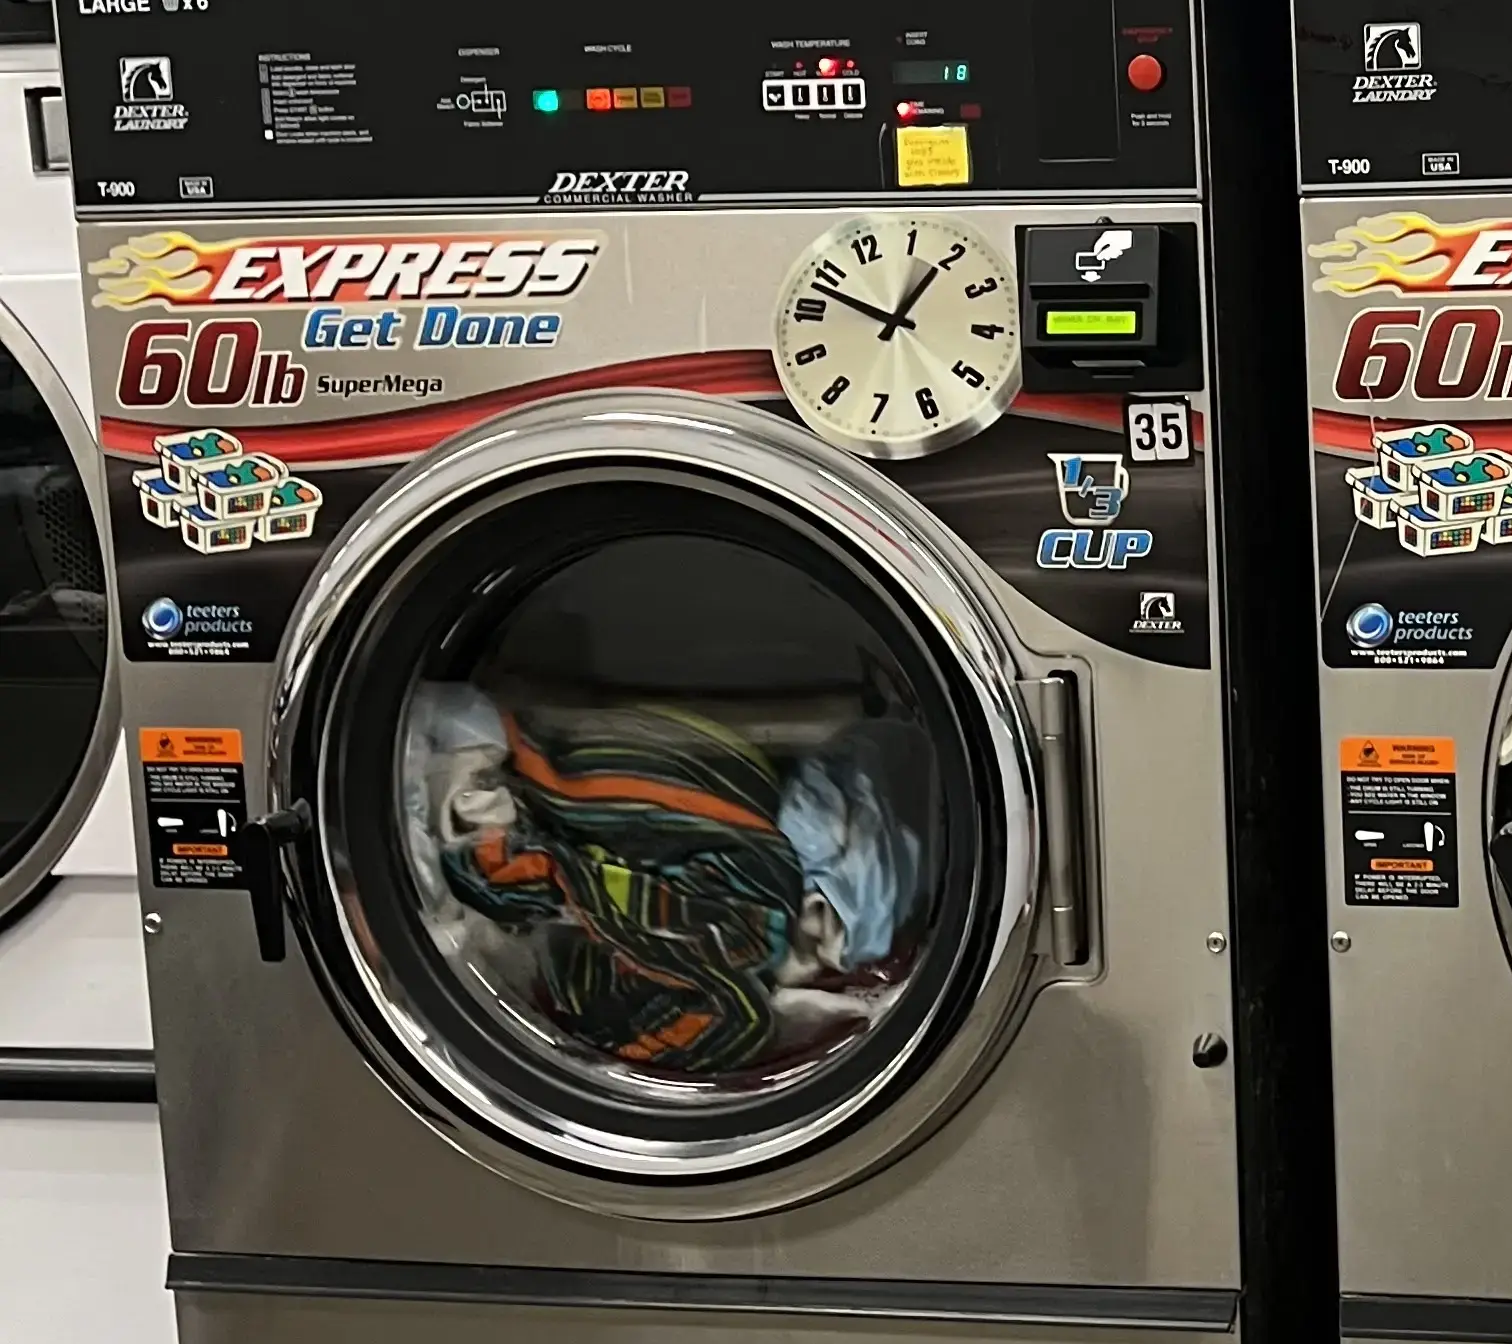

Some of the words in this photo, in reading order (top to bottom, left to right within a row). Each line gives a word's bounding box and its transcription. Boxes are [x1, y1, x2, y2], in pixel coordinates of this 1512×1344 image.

[771, 40, 794, 49] WASH
[795, 39, 851, 48] TEMPERATURE
[1352, 74, 1437, 89] DEXTER
[1352, 88, 1437, 103] LAUNDRY
[113, 104, 189, 119] DEXTER
[114, 118, 188, 131] LAUNDRY
[1327, 158, 1371, 175] T-900
[1430, 162, 1452, 172] USA
[97, 181, 136, 197] T-900
[548, 170, 689, 193] DEXTER
[543, 192, 631, 204] COMMERCIAL
[637, 191, 693, 203] WASHER
[851, 234, 883, 265] 12
[907, 229, 917, 256] 1
[938, 243, 966, 271] 2
[209, 239, 600, 303] EXPRESS
[815, 259, 847, 288] 11
[964, 277, 998, 299] 3
[794, 298, 827, 322] 10
[303, 306, 405, 350] Get
[416, 306, 562, 349] Done
[971, 324, 1004, 340] 4
[115, 318, 307, 409] 60lb
[795, 344, 827, 366] 9
[951, 360, 985, 388] 5
[315, 374, 444, 397] SuperMega
[821, 376, 850, 405] 8
[870, 393, 889, 423] 7
[915, 387, 939, 420] 6
[1134, 412, 1183, 452] 35
[1037, 529, 1153, 569] CUP
[186, 604, 240, 618] teeters
[1398, 611, 1459, 624] teeters
[184, 619, 253, 637] products
[1132, 619, 1183, 630] DEXTER
[1393, 625, 1474, 644] products
[1350, 649, 1468, 657] www.teetersproducts.com
[1375, 861, 1428, 869] IMPORTANT
